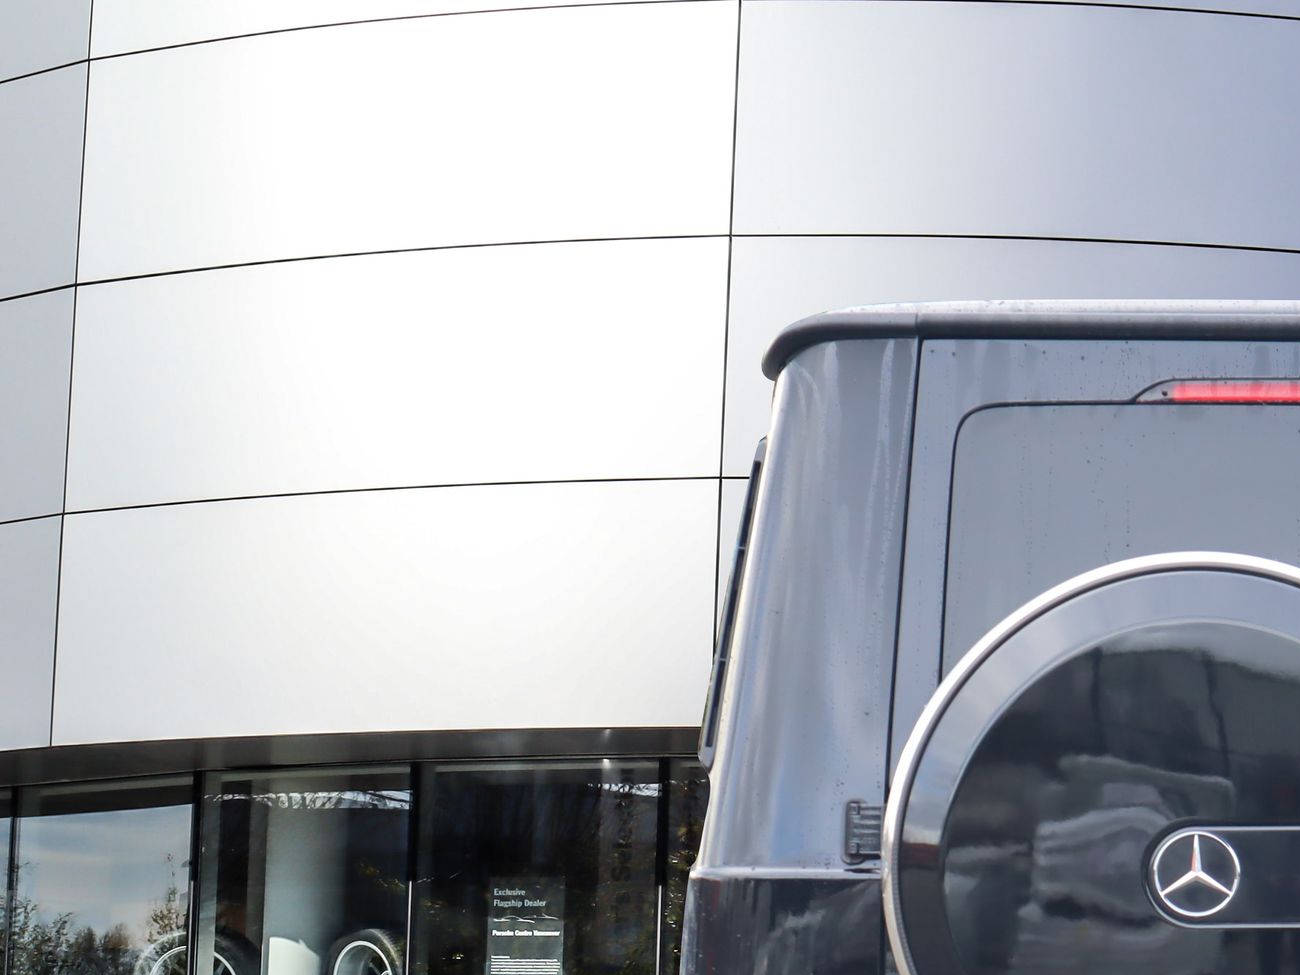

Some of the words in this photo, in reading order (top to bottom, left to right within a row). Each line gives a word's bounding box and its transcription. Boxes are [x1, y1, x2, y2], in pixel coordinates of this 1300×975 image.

[493, 888, 526, 896] Exclusive
[493, 899, 523, 908] Flagship
[524, 899, 547, 907] Dealer
